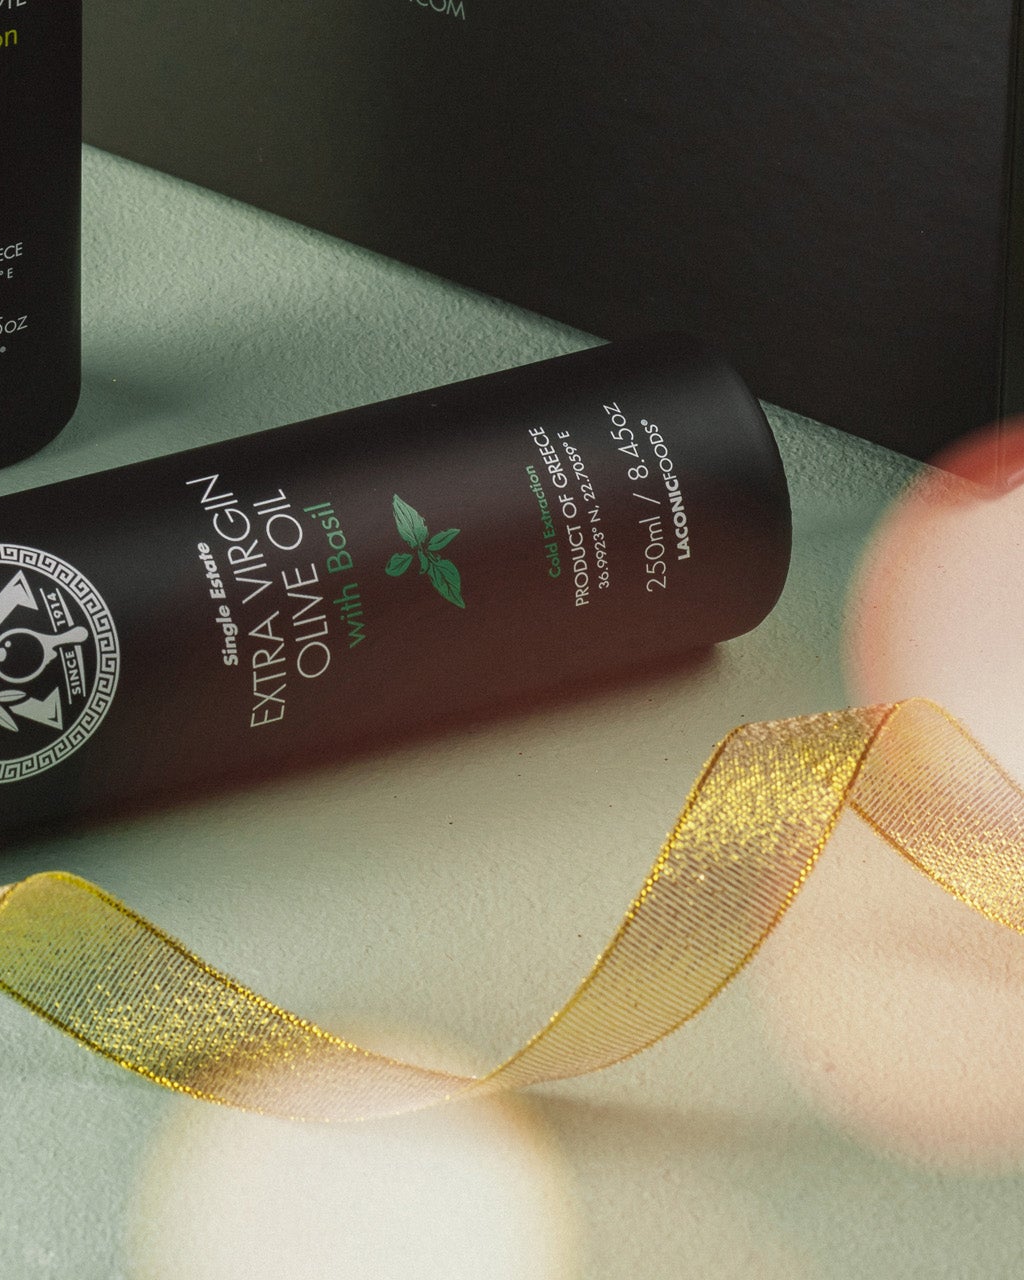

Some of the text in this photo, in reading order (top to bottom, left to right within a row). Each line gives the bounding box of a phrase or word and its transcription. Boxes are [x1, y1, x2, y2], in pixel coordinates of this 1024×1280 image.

[7, 267, 14, 279] E
[557, 430, 570, 439] E
[602, 401, 667, 592] 250ml / 8.45oz
[303, 502, 366, 648] with Basil
[526, 465, 561, 578] Cold Extraction
[528, 426, 589, 607] PRODUCT OF GREECE
[587, 505, 601, 523] N,
[47, 591, 82, 696] SINCE 1914
[185, 474, 287, 728] EXTRA VIRGIN
[197, 542, 238, 666] Single Estate
[253, 488, 331, 678] OLIVE OIL
